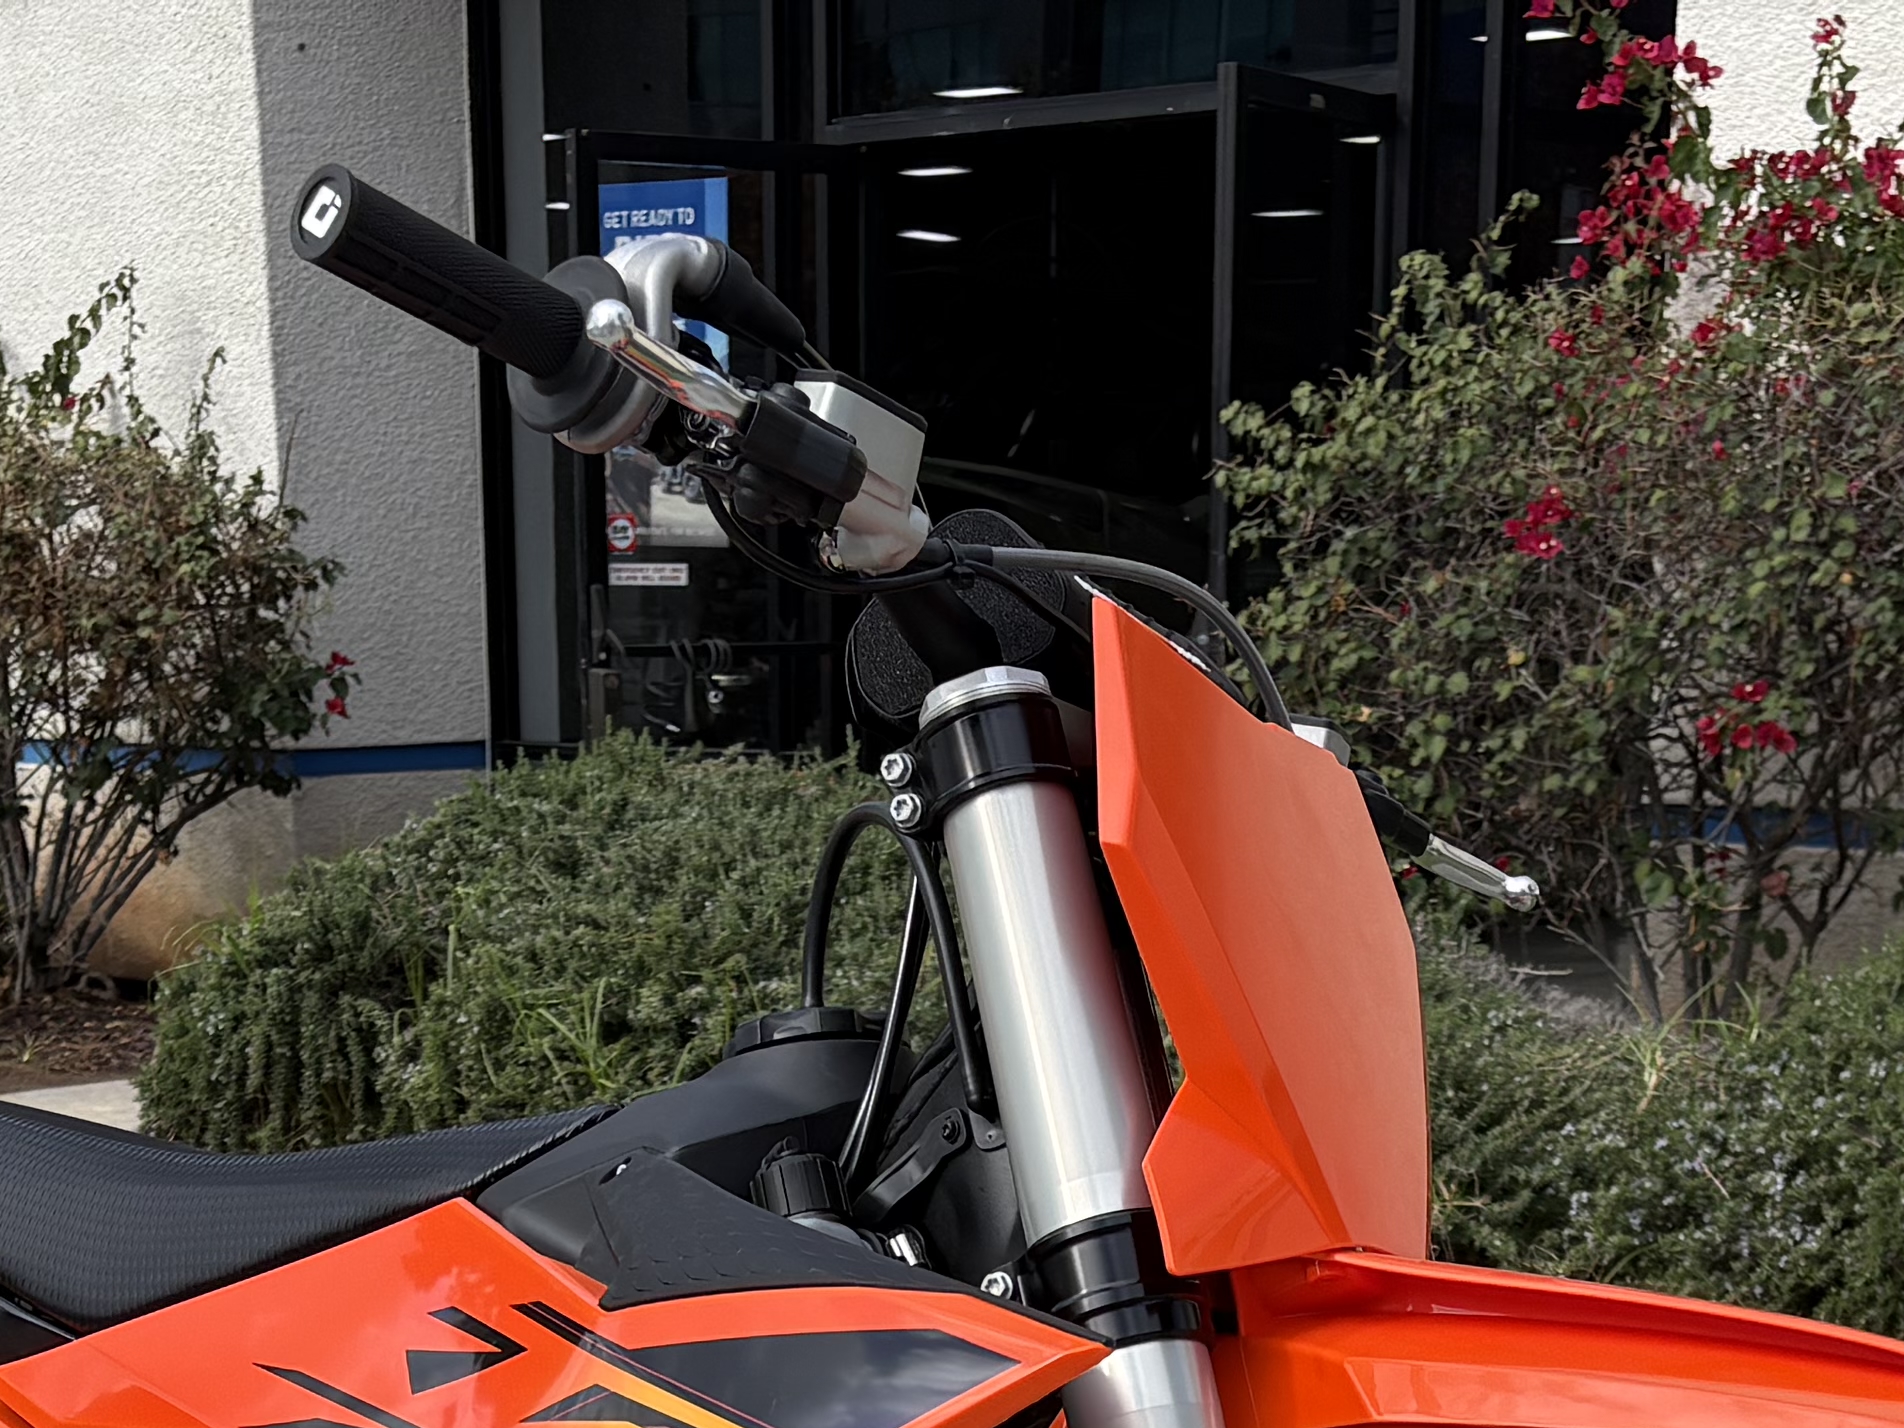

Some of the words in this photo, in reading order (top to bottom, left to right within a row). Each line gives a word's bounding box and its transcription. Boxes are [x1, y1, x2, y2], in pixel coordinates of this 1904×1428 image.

[602, 210, 629, 230] GET
[630, 208, 675, 228] READY
[677, 207, 695, 226] TO
